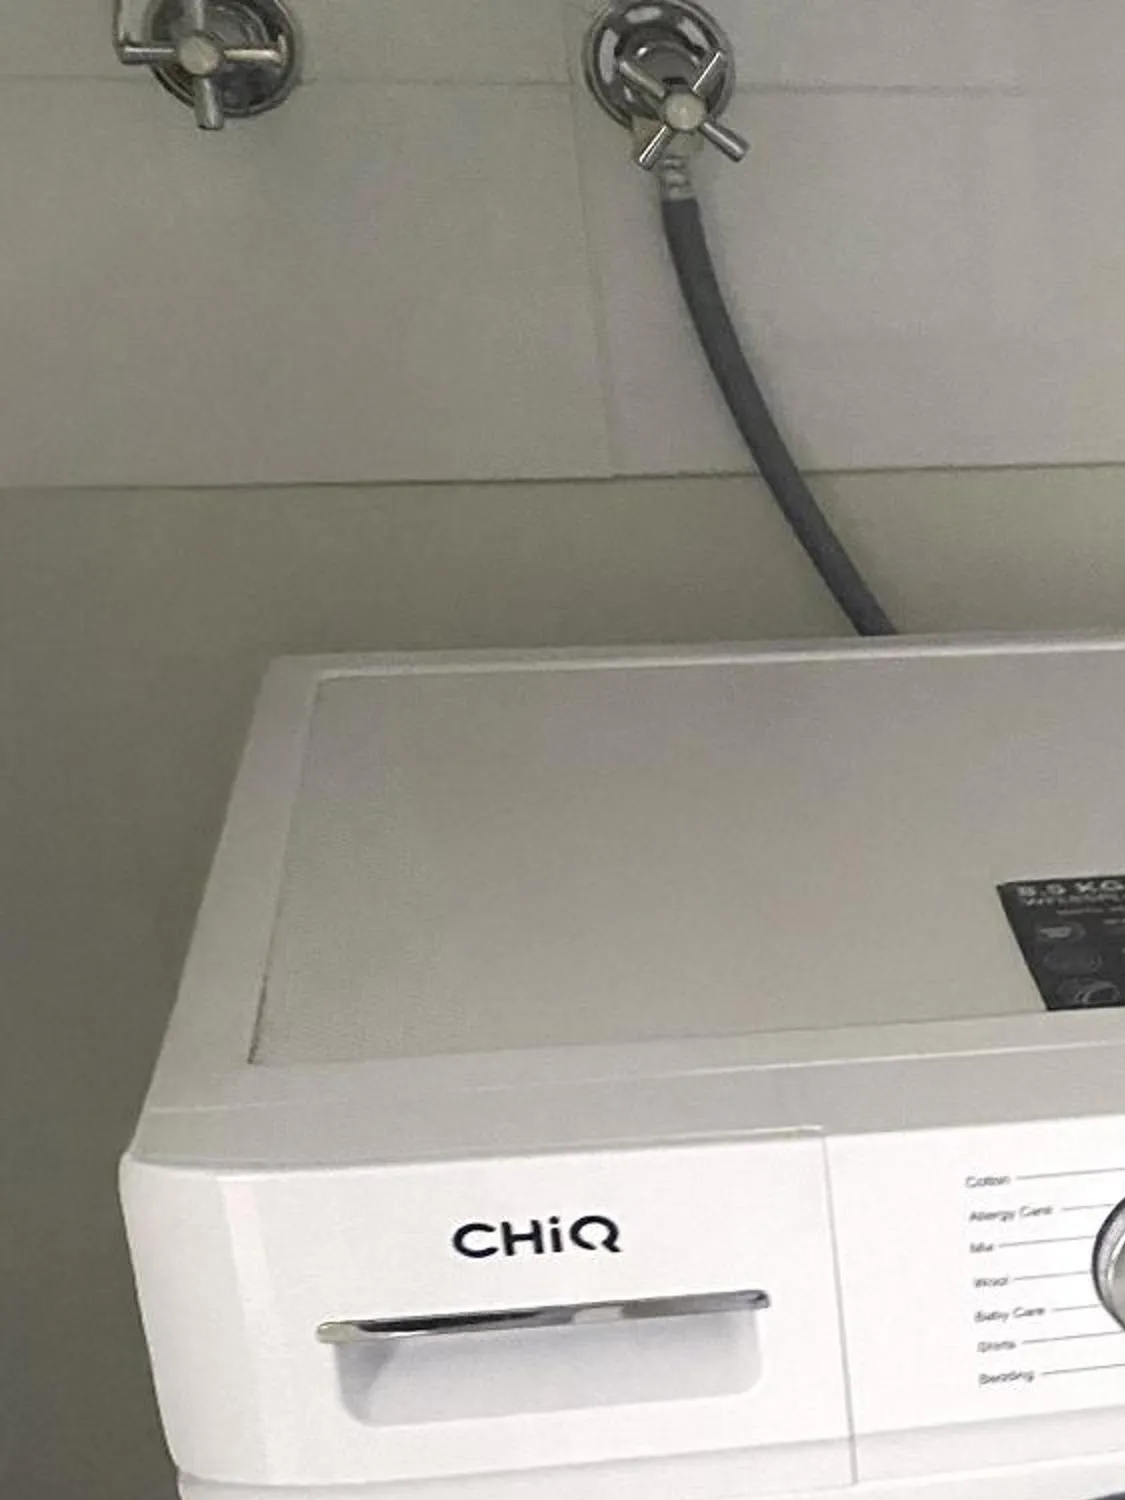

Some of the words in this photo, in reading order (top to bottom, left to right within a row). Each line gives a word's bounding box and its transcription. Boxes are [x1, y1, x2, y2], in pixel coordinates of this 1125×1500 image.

[964, 1175, 1011, 1188] Cotton
[969, 1209, 1016, 1222] Allergy
[1019, 1205, 1053, 1218] Care
[452, 1215, 622, 1259] CHiQ
[1012, 1306, 1046, 1319] Care
